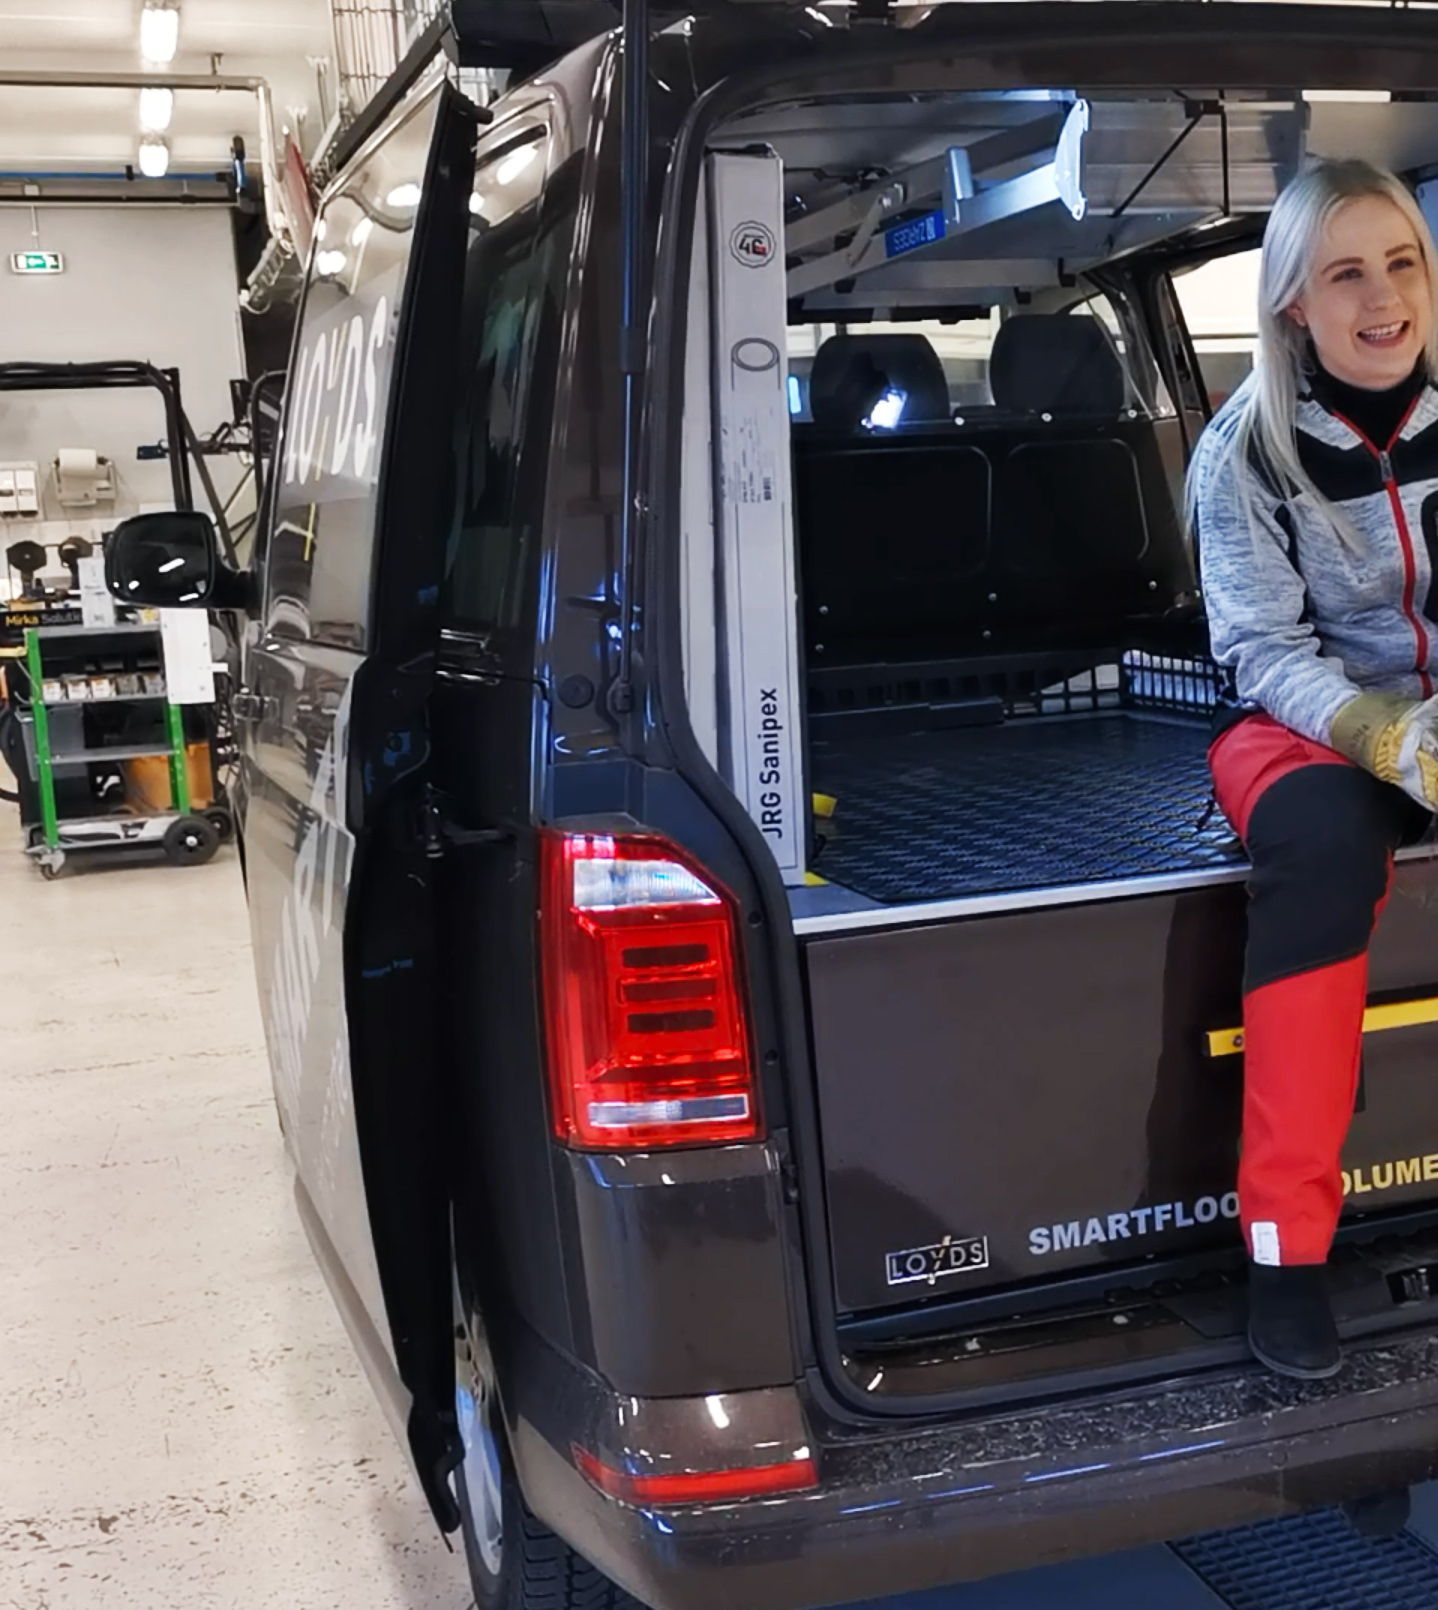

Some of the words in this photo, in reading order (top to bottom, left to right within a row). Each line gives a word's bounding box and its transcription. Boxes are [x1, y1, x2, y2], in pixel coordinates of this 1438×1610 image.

[6, 613, 39, 627] Mirka
[758, 688, 784, 784] Sanipex
[761, 792, 783, 839] JRG
[890, 1236, 984, 1284] LOYDS
